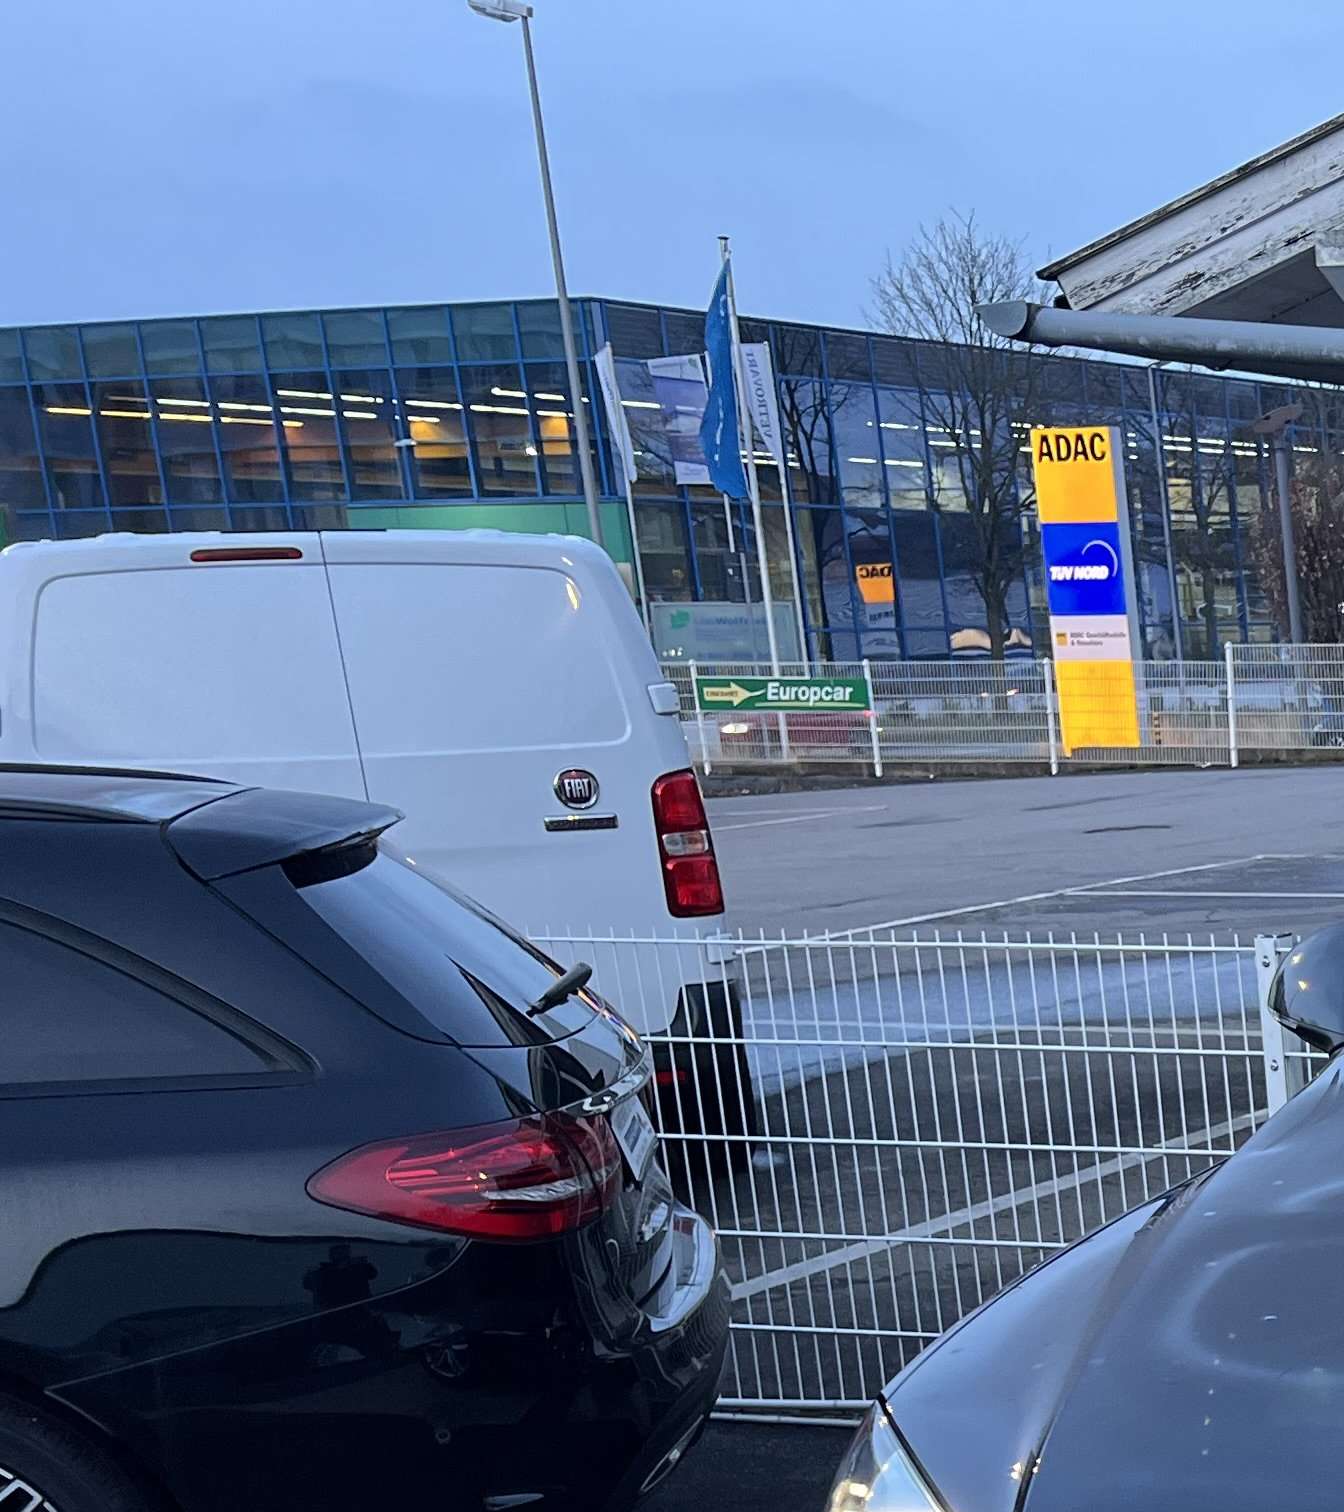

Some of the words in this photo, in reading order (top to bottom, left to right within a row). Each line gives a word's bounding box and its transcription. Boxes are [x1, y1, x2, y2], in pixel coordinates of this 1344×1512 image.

[1037, 431, 1106, 463] ADAC
[1073, 564, 1110, 581] NORD
[766, 681, 854, 707] Europcar
[563, 778, 590, 799] FIAT
